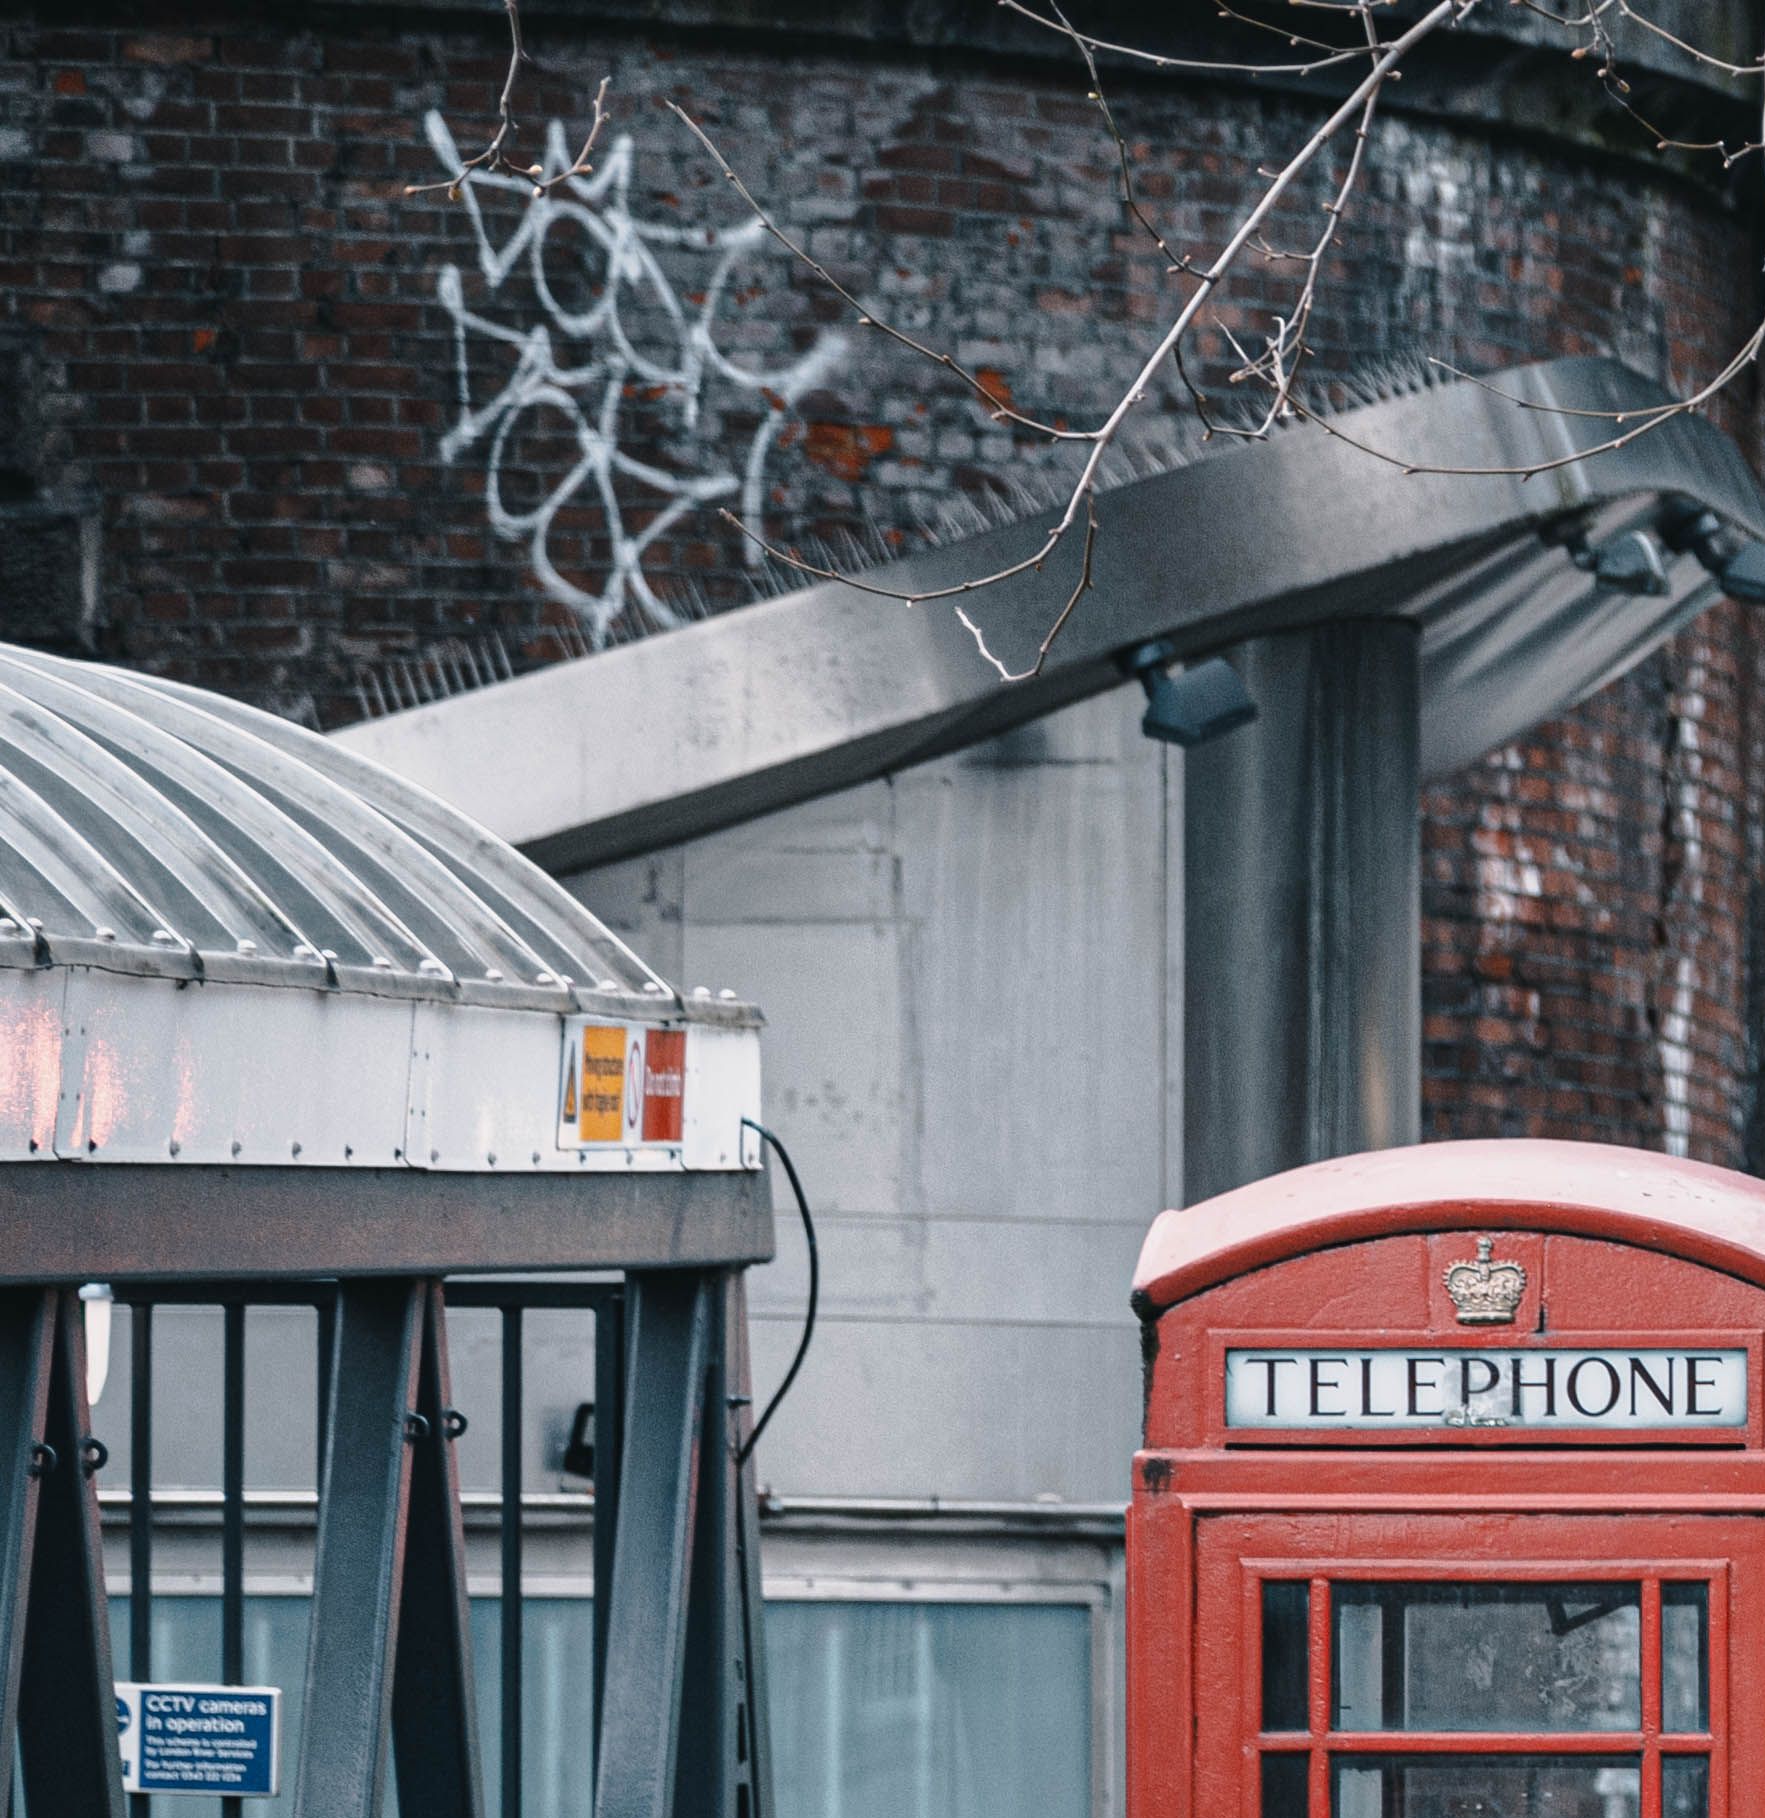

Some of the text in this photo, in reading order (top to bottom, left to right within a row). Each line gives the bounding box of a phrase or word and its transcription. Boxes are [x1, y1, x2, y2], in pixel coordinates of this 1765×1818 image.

[1245, 1356, 1723, 1418] TELEPHONE
[145, 1694, 267, 1716] CCTV cameras
[145, 1713, 245, 1735] in operation
